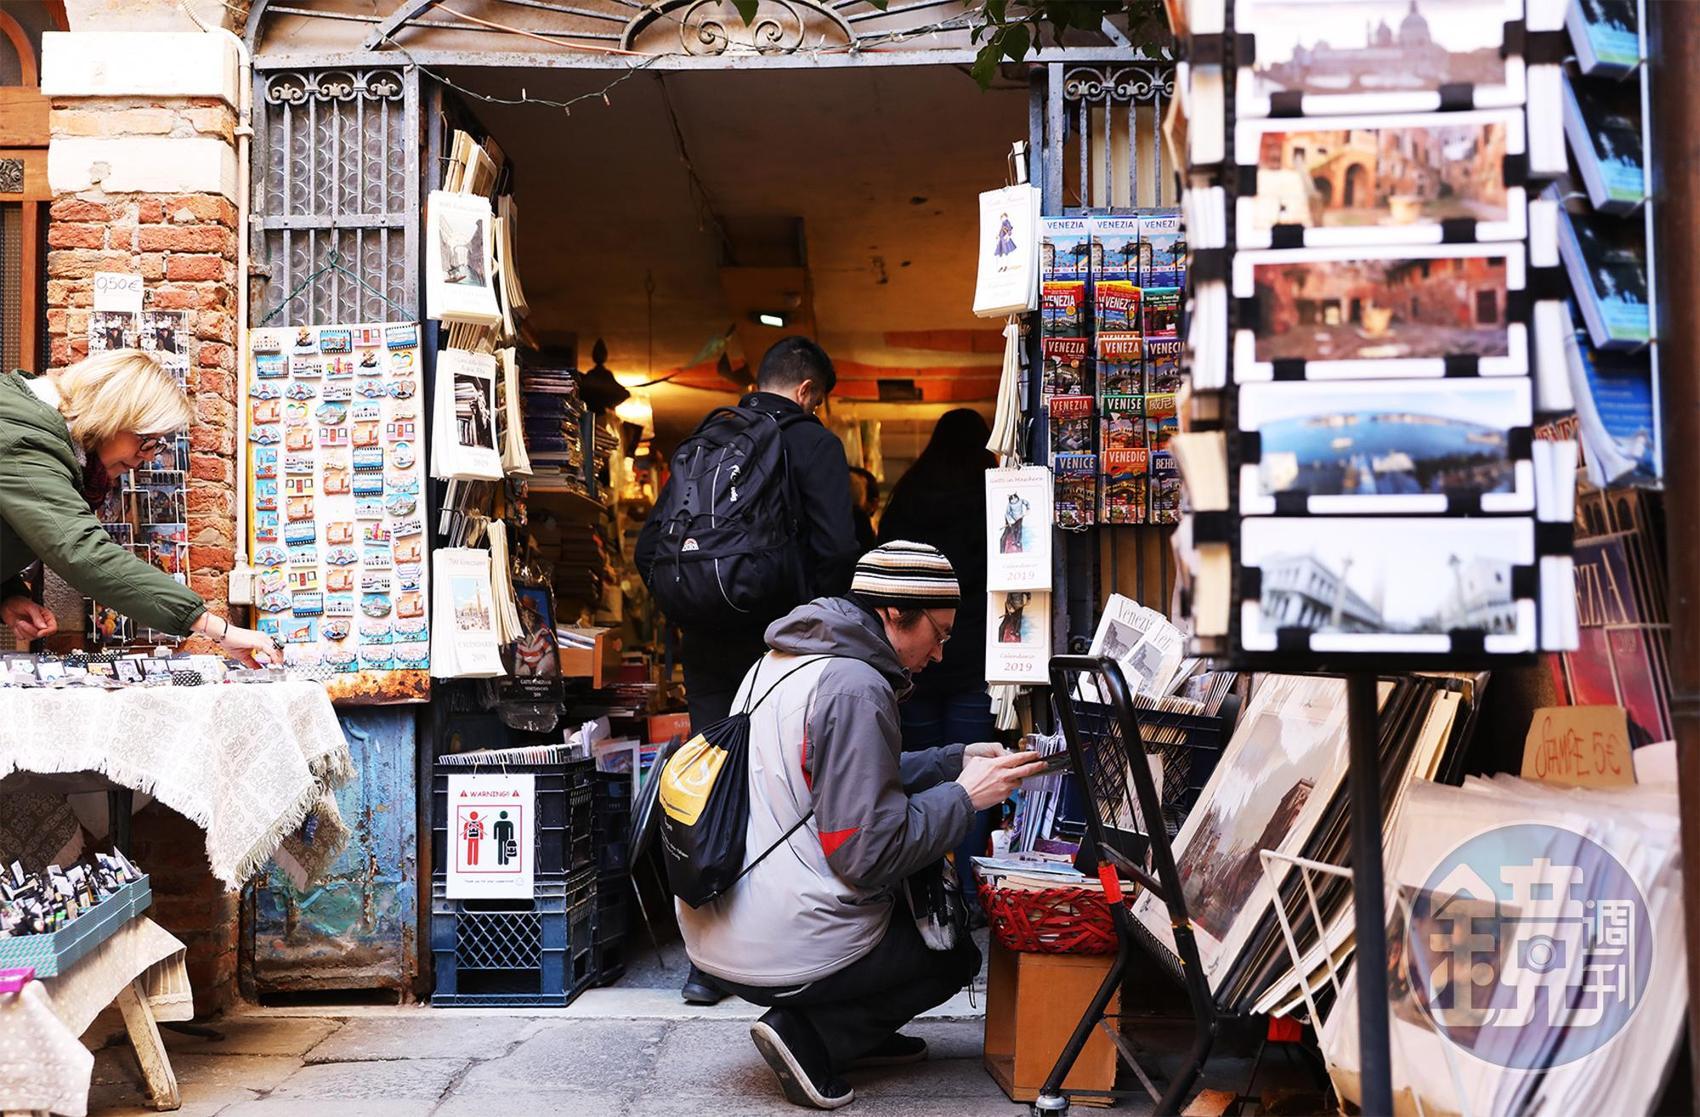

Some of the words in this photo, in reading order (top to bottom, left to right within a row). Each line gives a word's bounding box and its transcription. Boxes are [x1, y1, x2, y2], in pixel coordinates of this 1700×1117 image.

[1047, 220, 1084, 228] VENEZIA
[1097, 220, 1134, 228] VENEZIA
[1145, 219, 1176, 228] VENEZI
[1044, 295, 1076, 307] VENEZIA
[1104, 296, 1135, 311] VENEZA
[1048, 341, 1085, 354] VENEZIA
[1105, 342, 1139, 353] VENEZA
[1052, 400, 1089, 411] VENEZIA
[1108, 398, 1142, 410] VENISE
[1109, 451, 1146, 463] VENEDIG
[1060, 457, 1094, 469] VENICE
[1007, 571, 1035, 581] 2019
[1004, 662, 1032, 672] 2019
